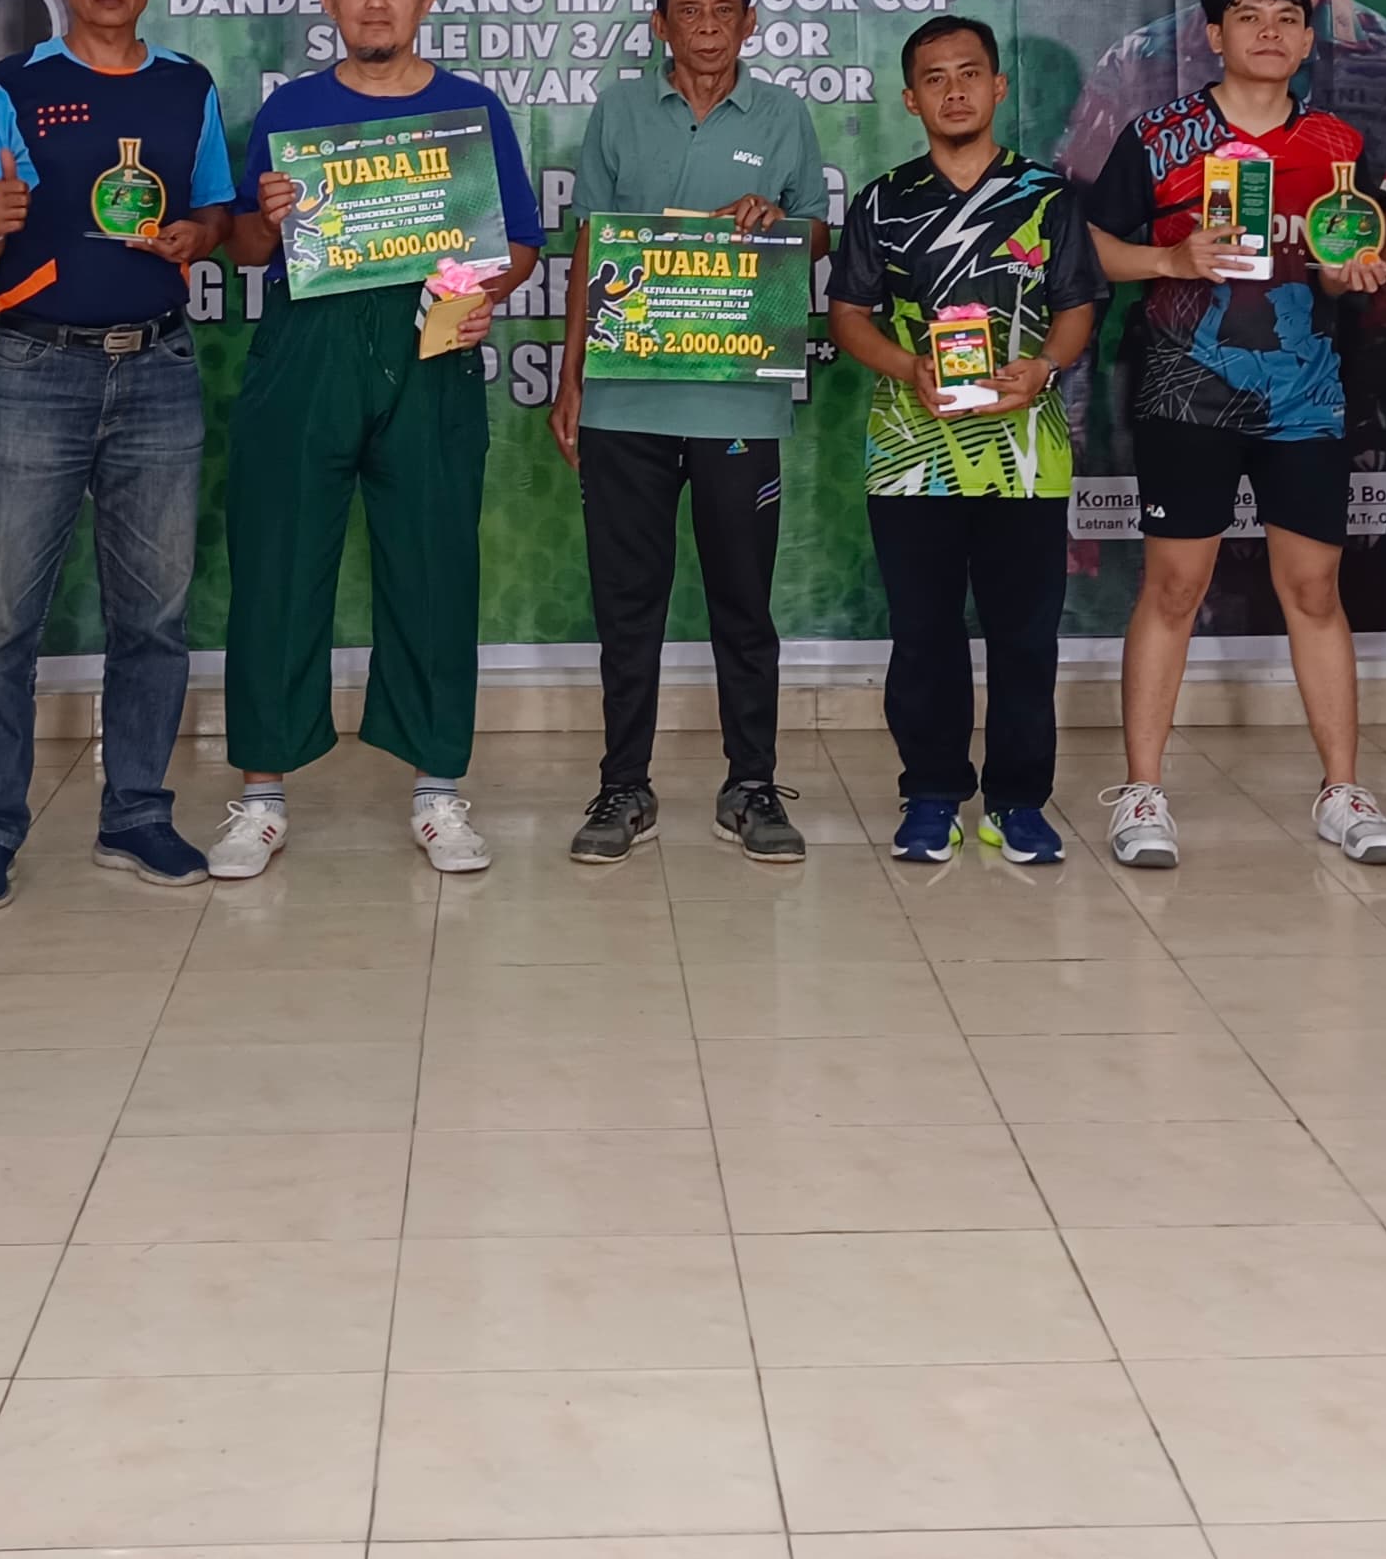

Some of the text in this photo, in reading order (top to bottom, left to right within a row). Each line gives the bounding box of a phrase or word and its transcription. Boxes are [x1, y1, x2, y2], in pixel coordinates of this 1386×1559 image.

[480, 24, 558, 59] DIV
[570, 23, 652, 59] 3/4
[323, 147, 450, 194] JUARA III
[326, 228, 476, 270] Rp. 1.000.000,-
[641, 250, 759, 281] JUARA II
[624, 332, 775, 360] Rp. 2.000.000,-
[1077, 518, 1124, 531] Letnan
